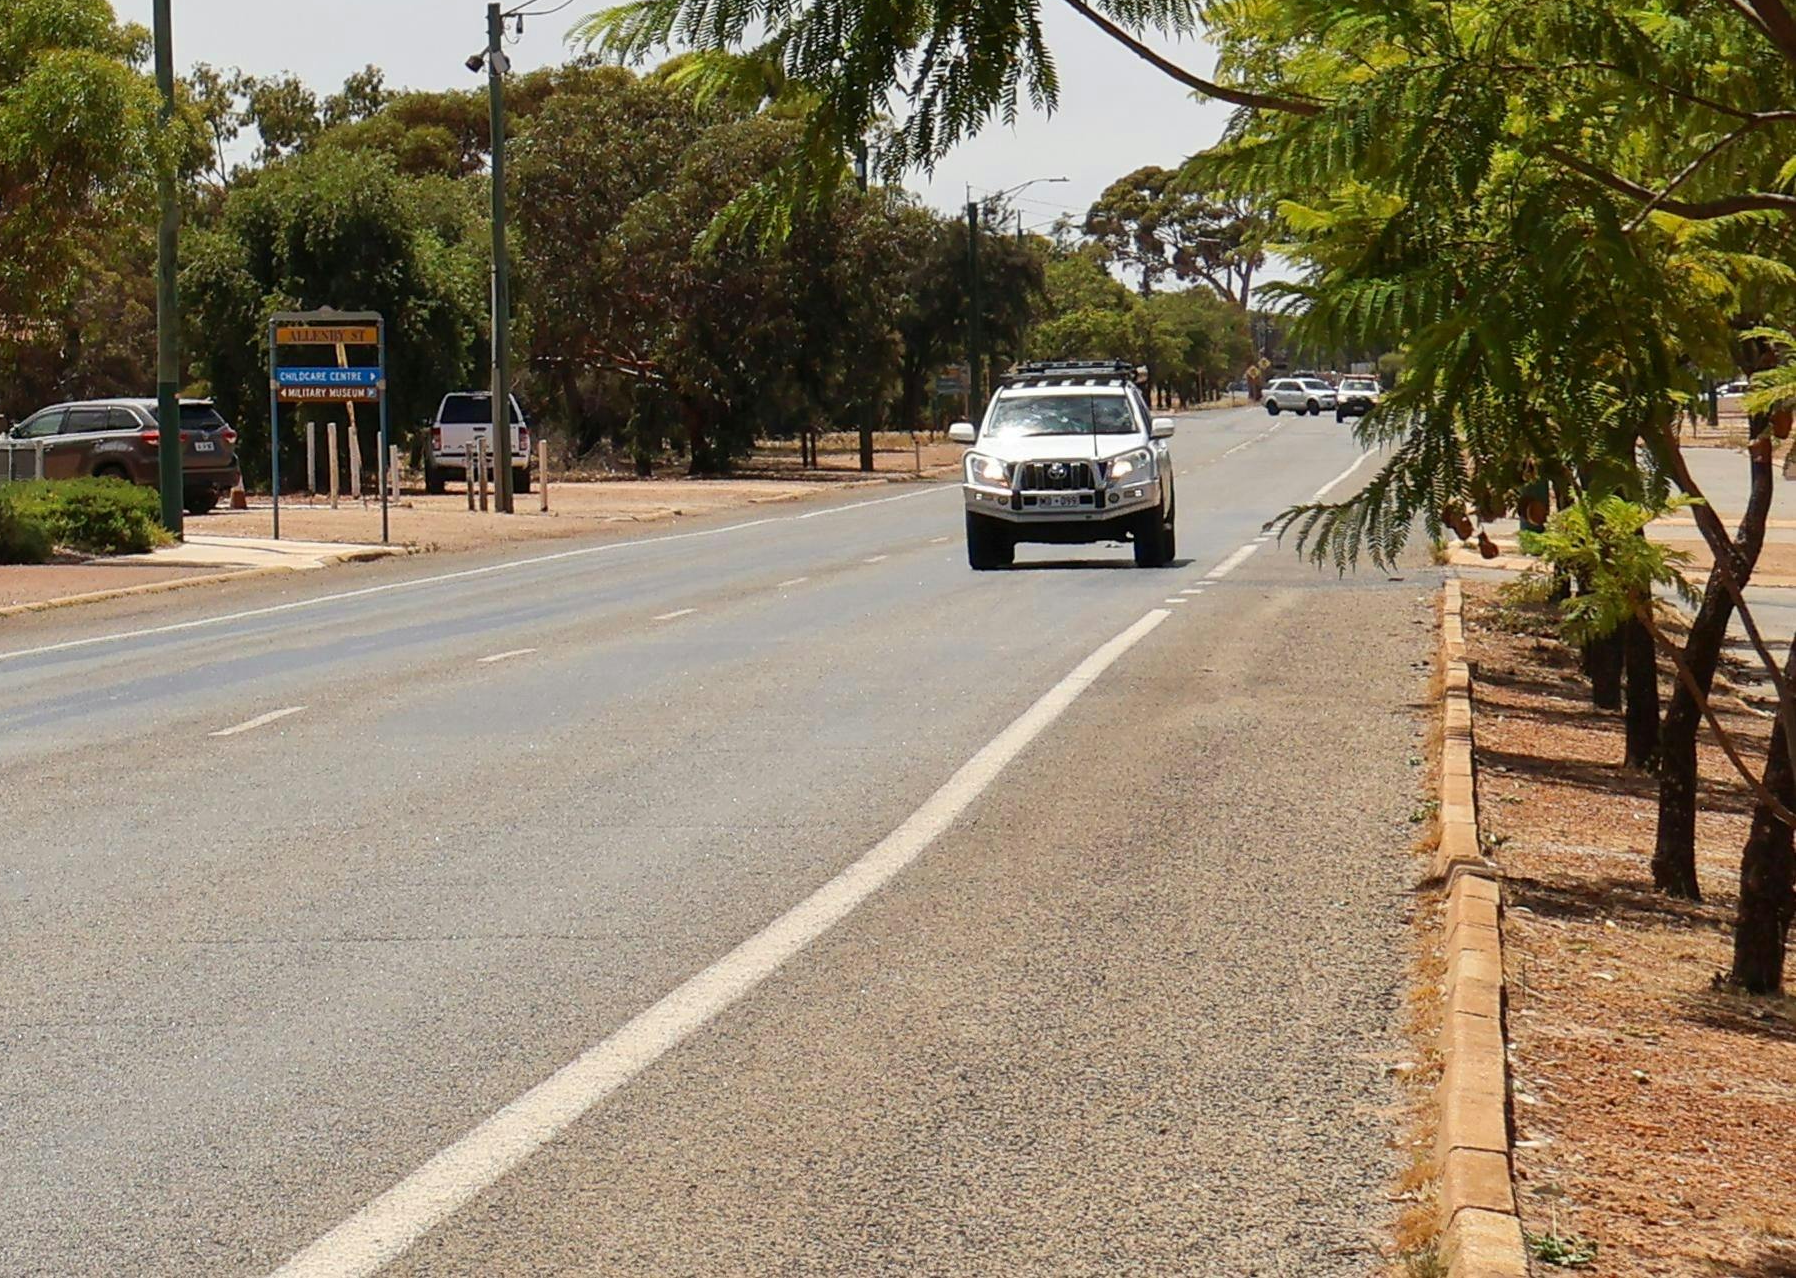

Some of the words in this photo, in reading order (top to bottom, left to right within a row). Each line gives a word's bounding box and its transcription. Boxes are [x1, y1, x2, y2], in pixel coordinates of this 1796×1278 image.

[290, 330, 345, 341] ALLENBY
[351, 330, 364, 341] ST
[279, 372, 327, 381] CHILDCARE
[329, 372, 362, 381] CENTRE
[288, 388, 327, 397] MILITARY
[329, 388, 365, 397] MUSEUM
